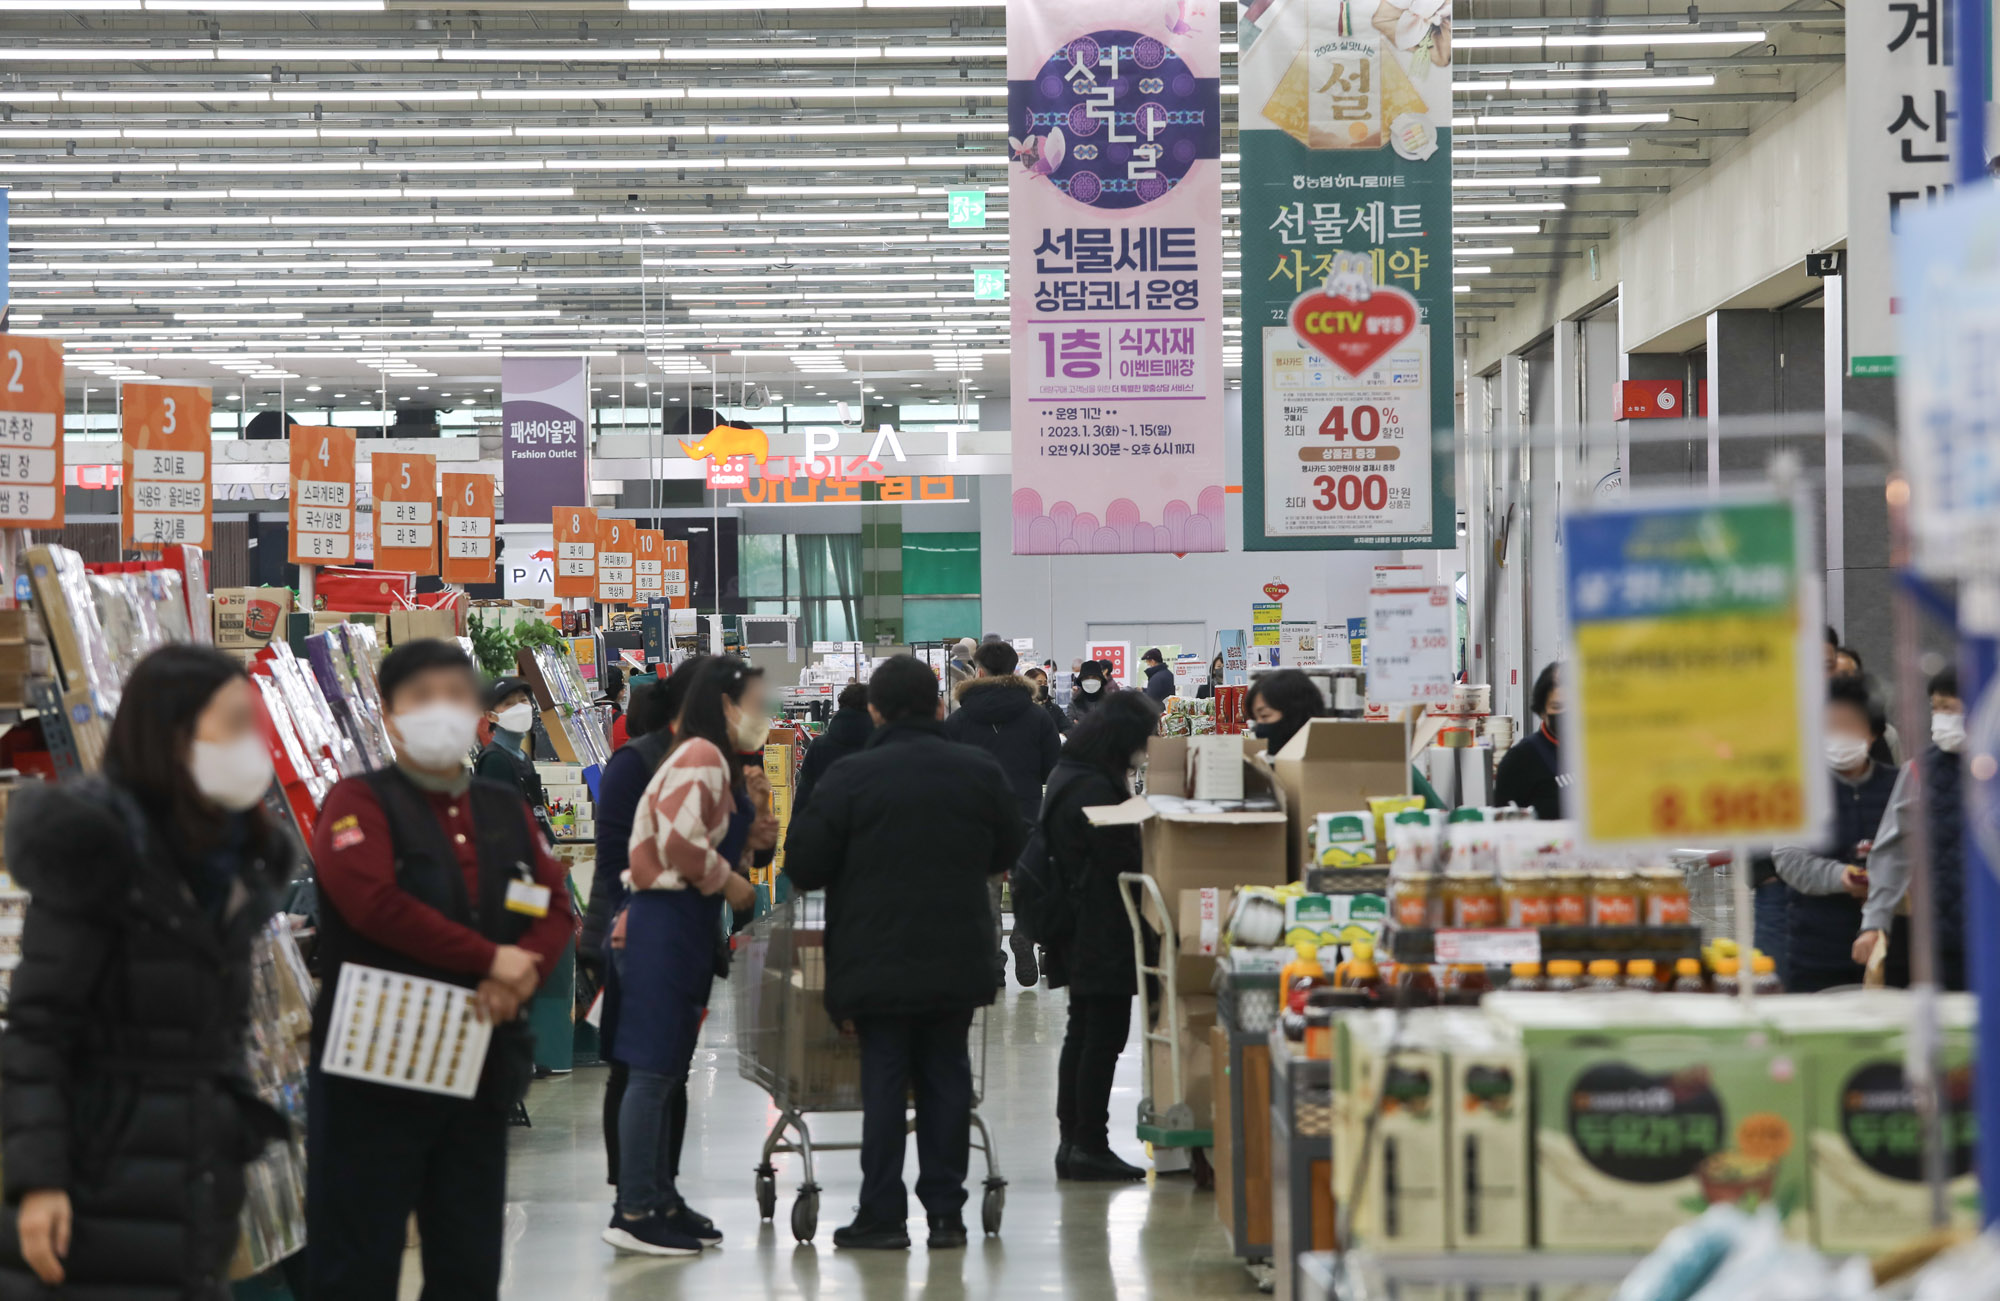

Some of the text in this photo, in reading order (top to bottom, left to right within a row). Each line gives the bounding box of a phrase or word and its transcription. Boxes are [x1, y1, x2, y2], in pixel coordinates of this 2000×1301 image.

[1317, 58, 1372, 121] 설
[1269, 201, 1427, 245] 선물세트
[1034, 227, 1198, 273] 선물세트
[1305, 311, 1364, 334] CCTV
[1119, 328, 1194, 356] 식자재
[1038, 329, 1102, 378] 1층
[8, 349, 24, 392] 2
[162, 397, 177, 434] 3
[1056, 407, 1101, 420] 운영 기간
[1284, 406, 1309, 414] 행사카드
[510, 420, 577, 444] 패션아울렛
[1284, 425, 1305, 436] 최대
[1382, 427, 1404, 439] 할인
[318, 437, 330, 467] 4
[512, 449, 577, 459] Fashion Outlet
[1048, 445, 1067, 456] 오전
[1070, 443, 1089, 456] 9시
[1092, 443, 1120, 456] 30분
[1131, 443, 1150, 455] 오후
[153, 455, 185, 476] 조미료
[401, 463, 411, 490] 5
[304, 485, 344, 503] 스파게티면
[465, 482, 475, 506] 6
[1285, 497, 1306, 508] 최대
[1312, 474, 1388, 511] 300
[153, 518, 186, 539] 참기름
[306, 511, 342, 529] 국수/냉면
[572, 514, 580, 534] 8
[612, 526, 620, 544] 9
[640, 535, 653, 552] 10
[666, 546, 677, 562] 11
